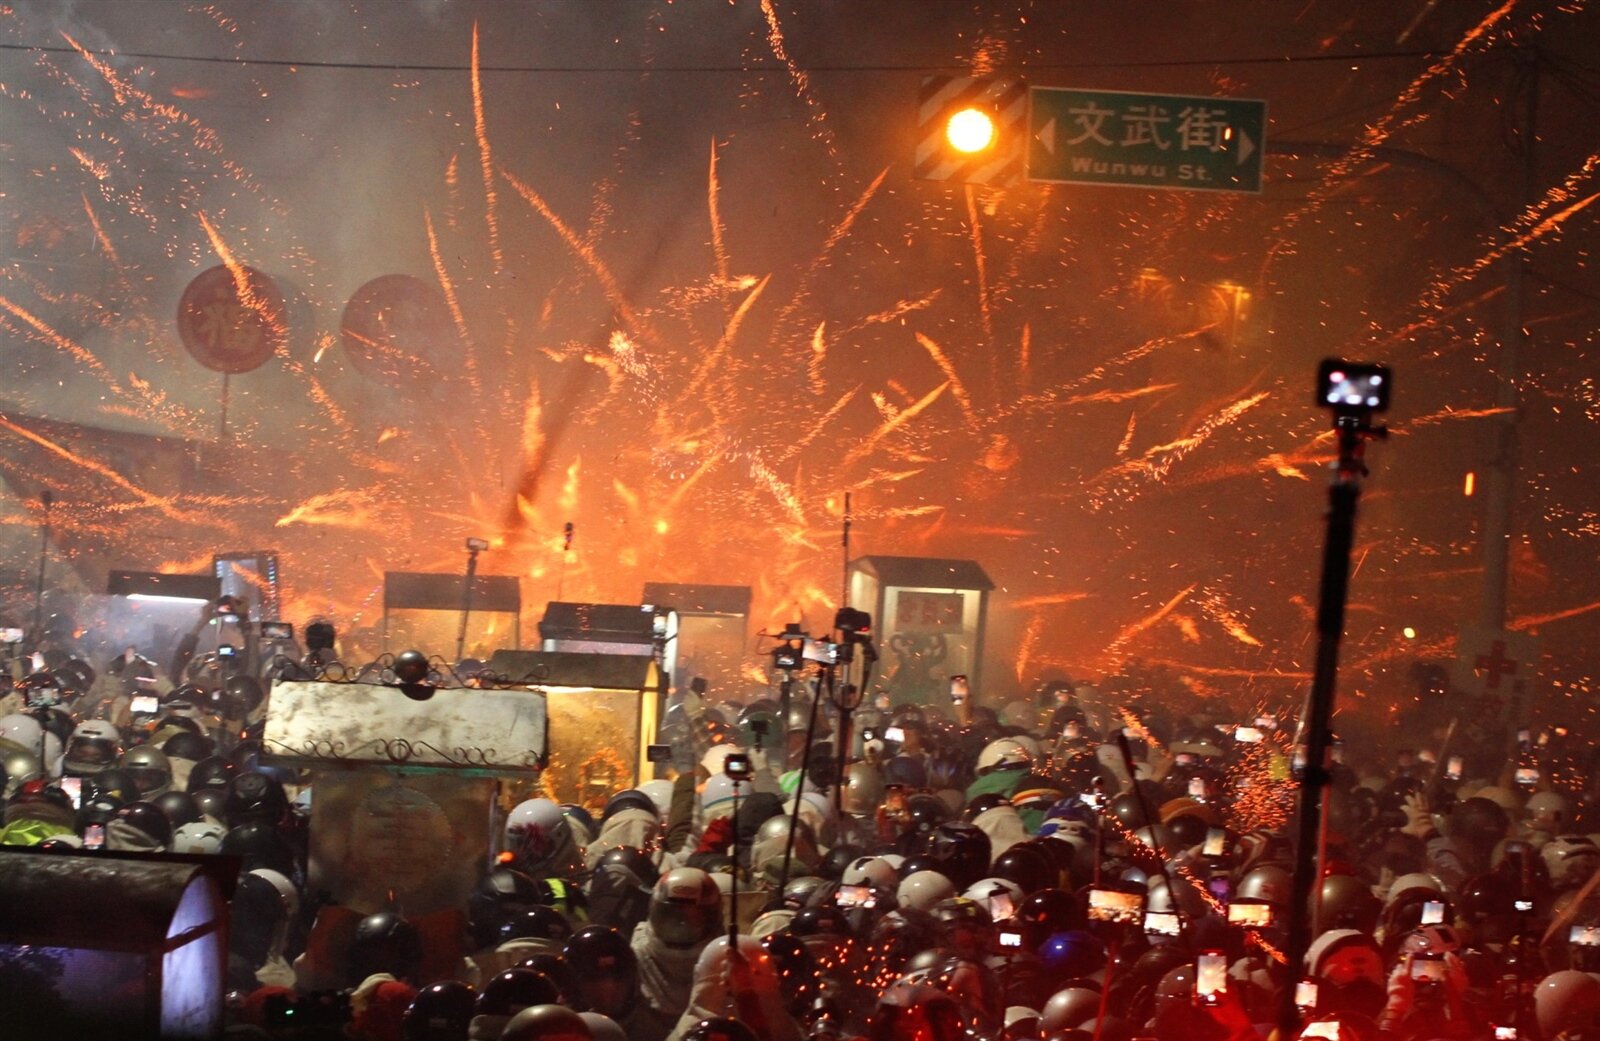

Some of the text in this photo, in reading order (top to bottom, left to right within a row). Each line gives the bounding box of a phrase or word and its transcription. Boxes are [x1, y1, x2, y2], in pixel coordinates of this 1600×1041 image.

[1067, 102, 1227, 152] 文武街
[1072, 157, 1212, 181] Wunwu St.
